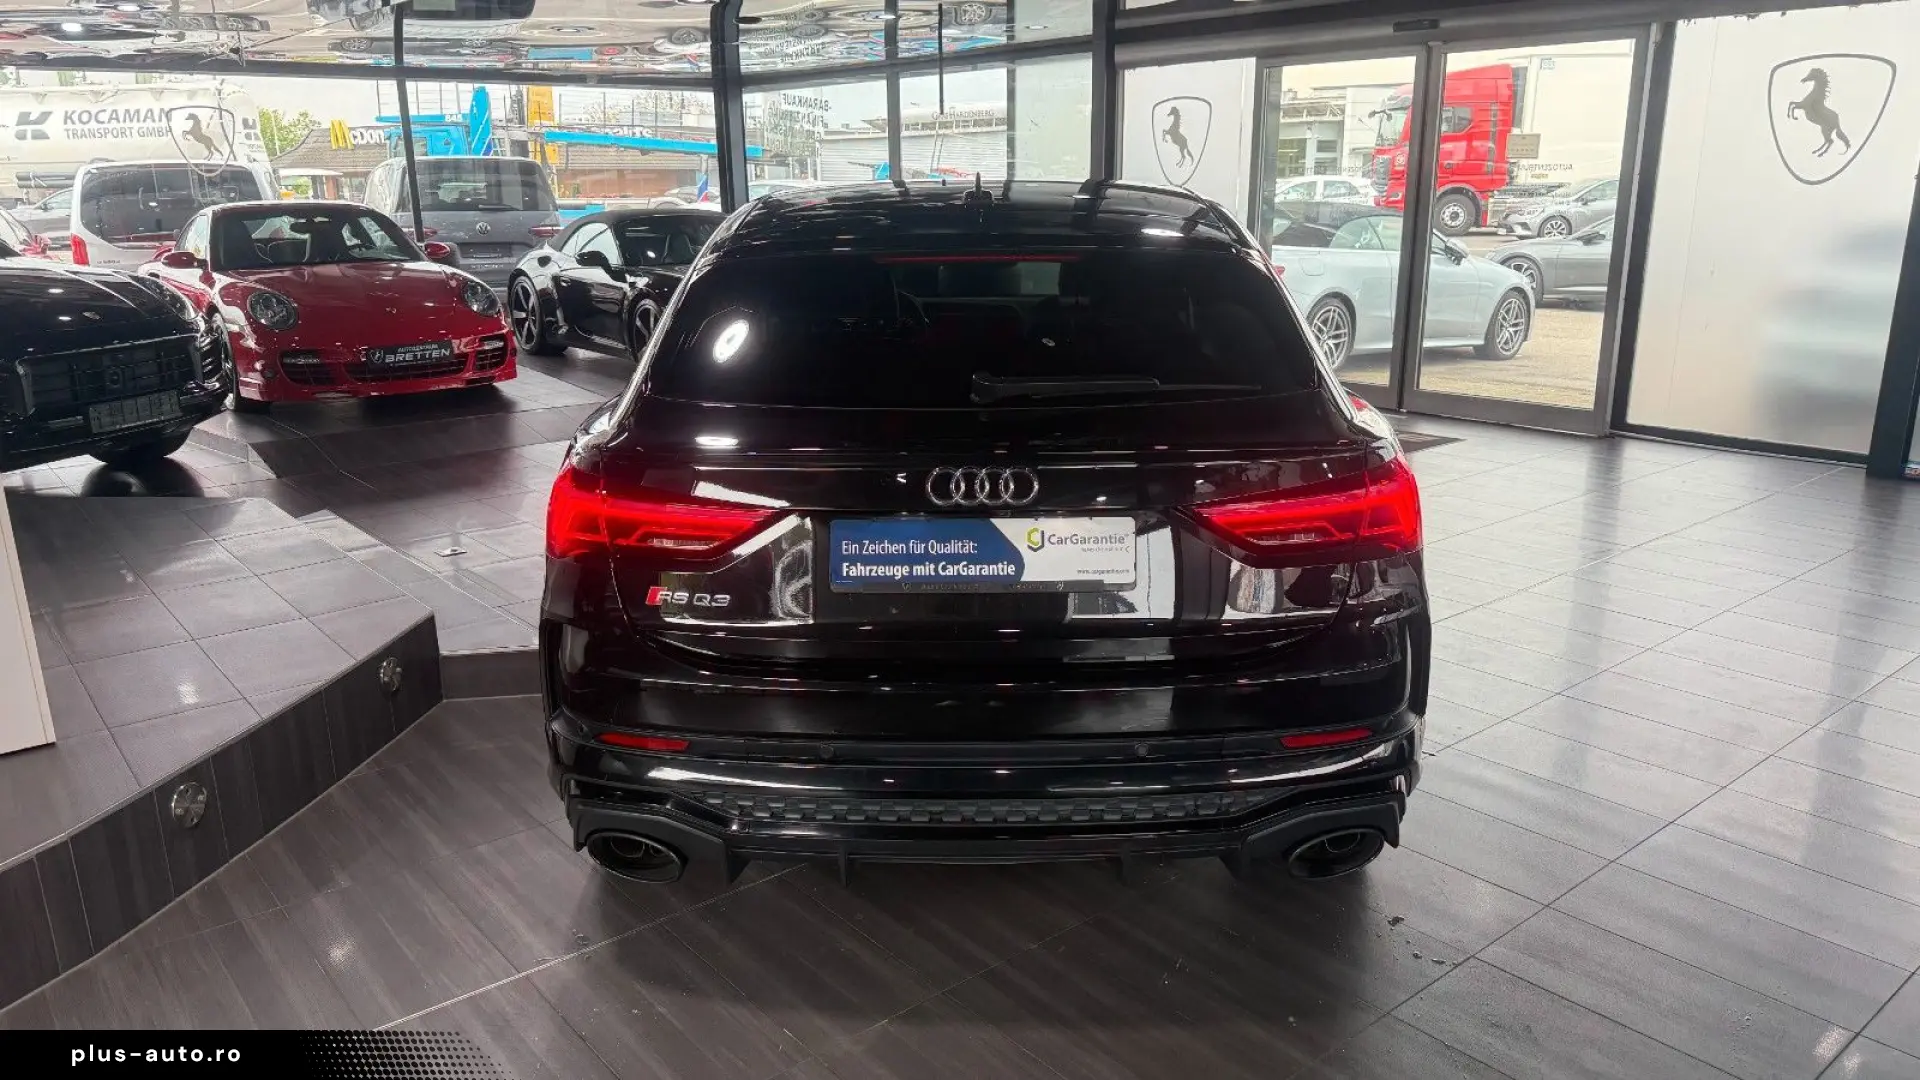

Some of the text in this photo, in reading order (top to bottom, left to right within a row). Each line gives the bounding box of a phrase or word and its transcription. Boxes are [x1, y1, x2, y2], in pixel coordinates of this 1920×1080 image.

[63, 107, 173, 126] KOCAMAN
[64, 124, 172, 140] TRANSPORT GMBH
[385, 348, 451, 363] BRETTEN
[842, 538, 978, 556] Ein Zeichen für Qualität:
[1048, 533, 1126, 546] CarGarantie
[842, 561, 1017, 580] Fahrzeuge mit CarGarantie
[656, 590, 731, 607] RS Q3
